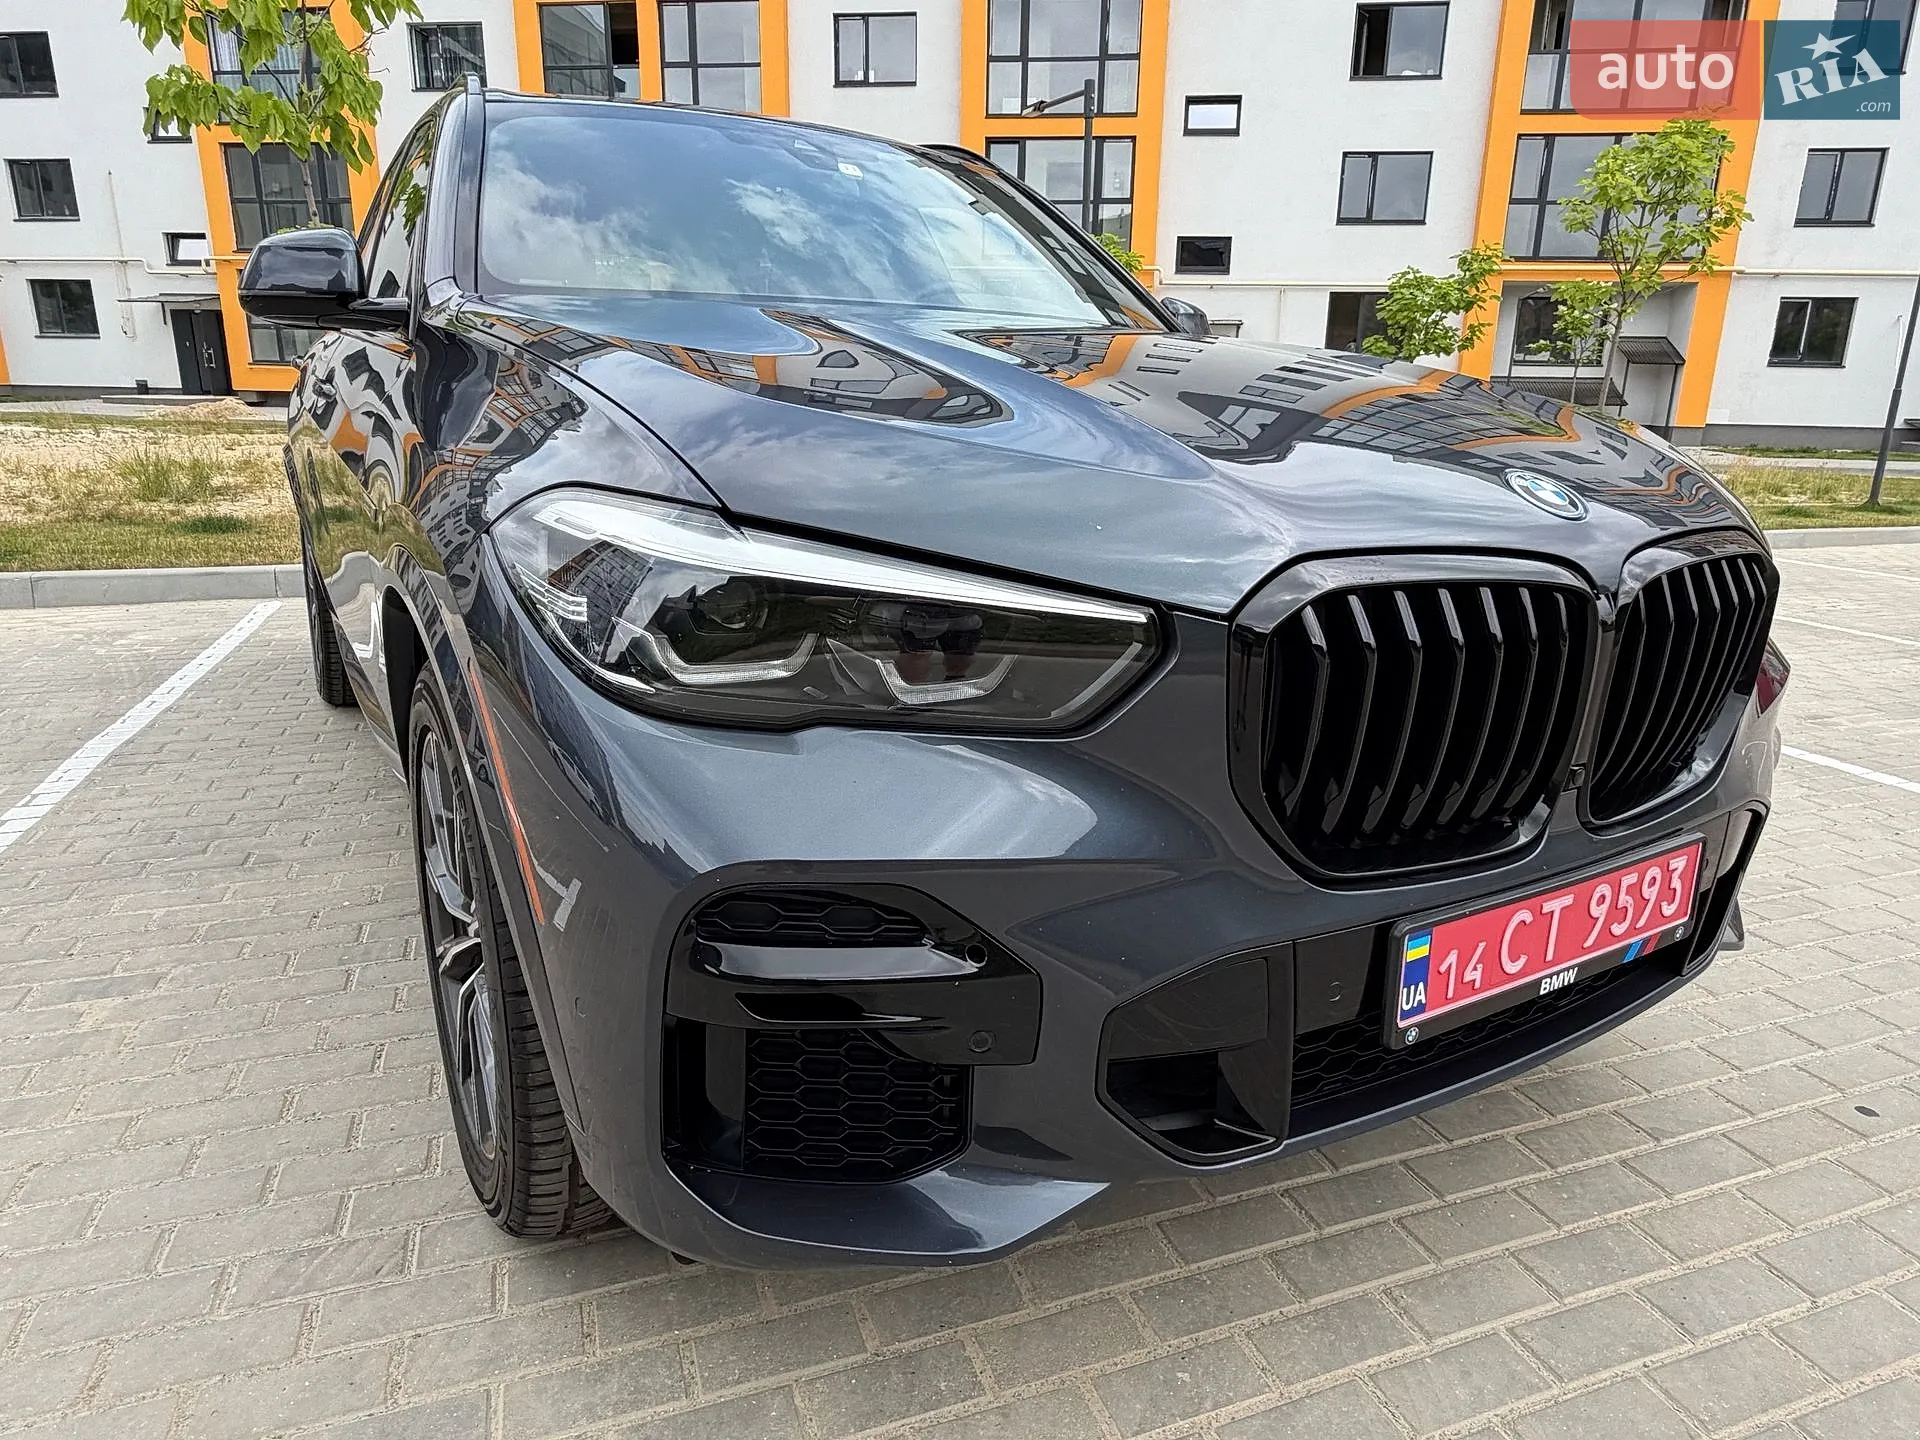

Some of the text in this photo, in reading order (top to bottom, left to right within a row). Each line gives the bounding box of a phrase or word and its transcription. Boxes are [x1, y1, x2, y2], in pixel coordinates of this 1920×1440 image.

[1438, 855, 1688, 999] 14 CT 9593
[1402, 981, 1426, 1011] UA
[1540, 967, 1578, 995] BMW
